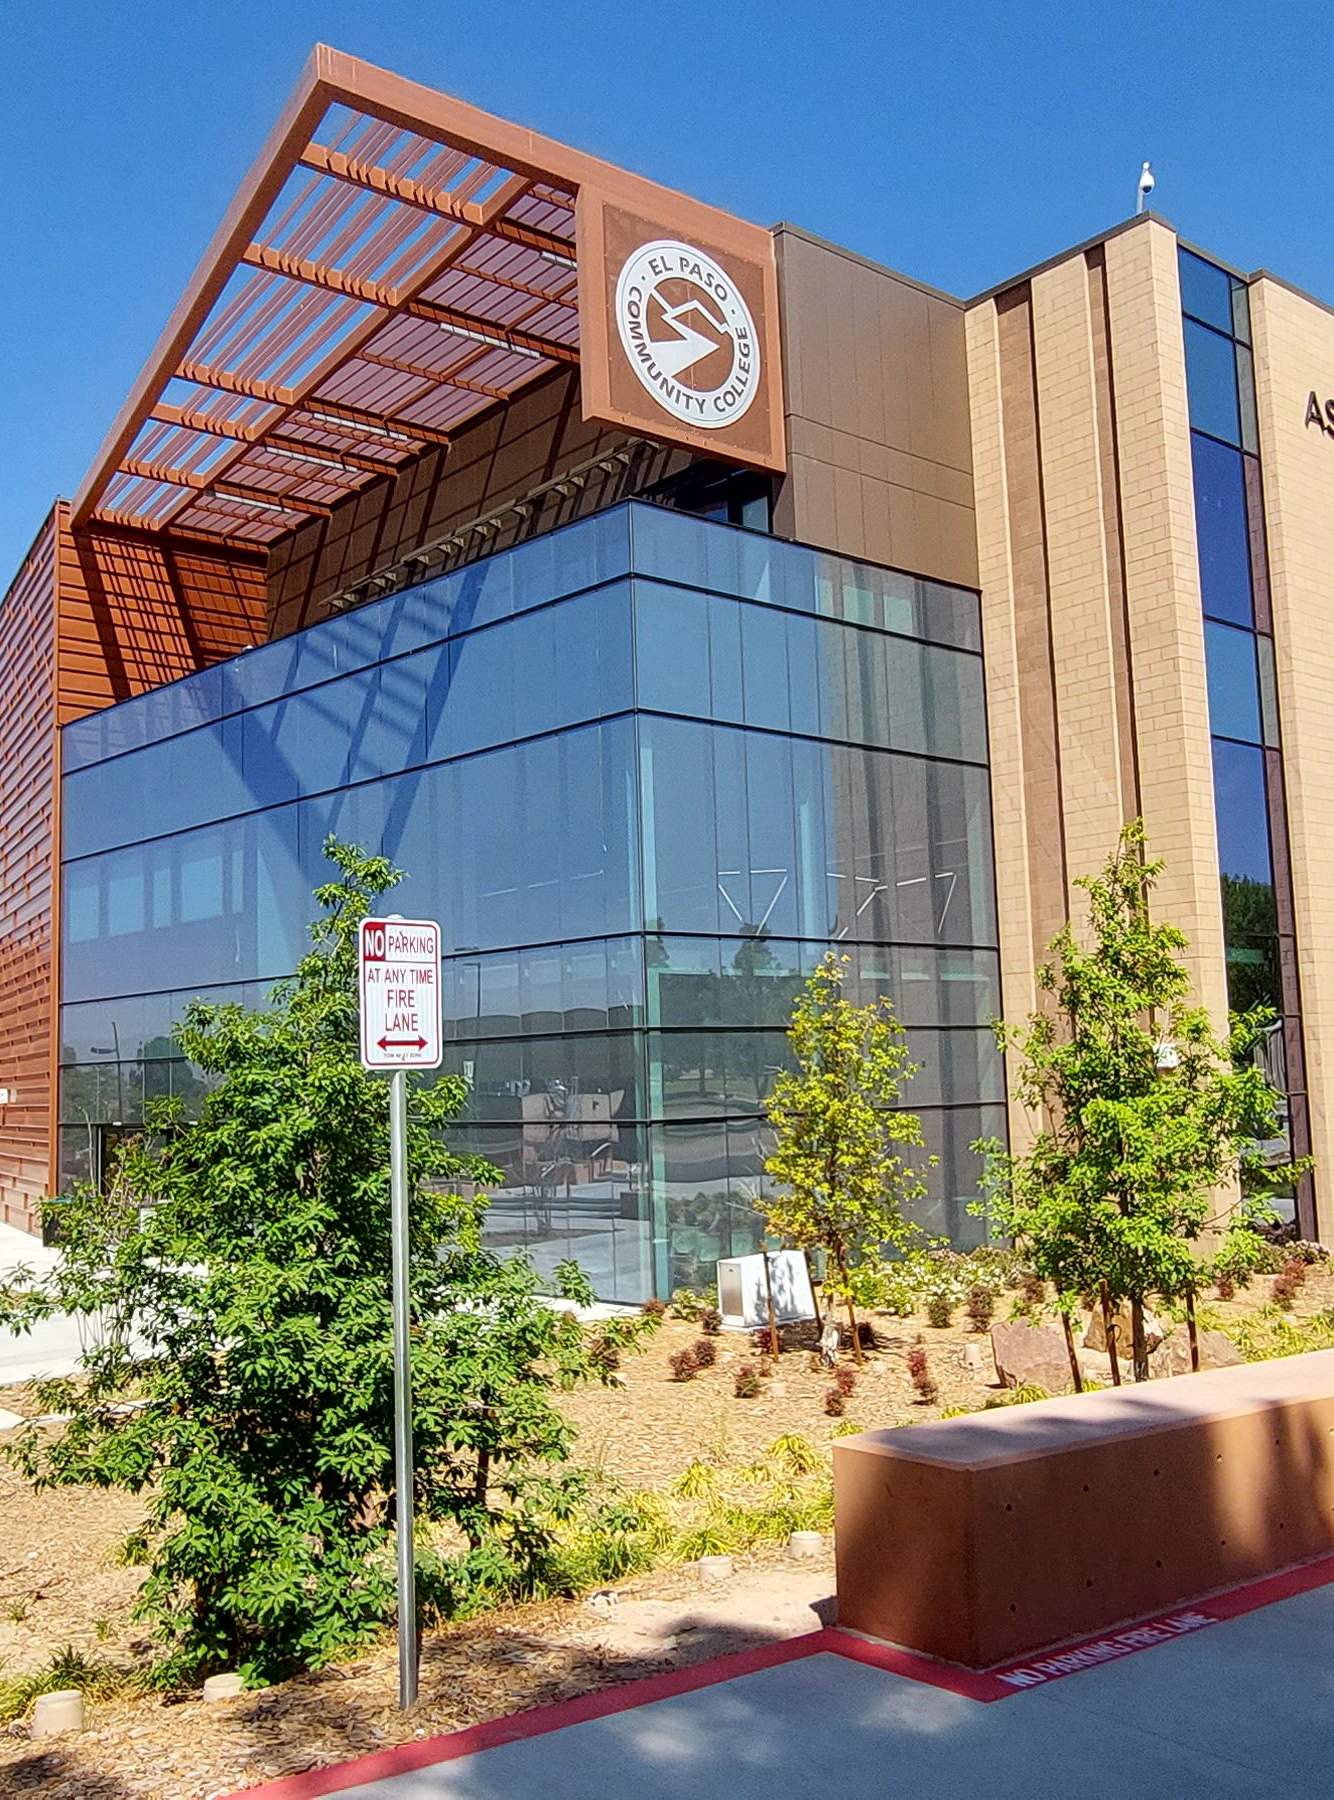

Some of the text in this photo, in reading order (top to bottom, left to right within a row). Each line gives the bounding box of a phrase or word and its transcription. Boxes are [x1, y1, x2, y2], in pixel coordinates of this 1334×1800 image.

[647, 255, 728, 302] EL PASO
[627, 285, 750, 415] COMMUNITY COLLEGE
[365, 929, 434, 957] NO PARKING
[367, 967, 434, 985] AT ANY TIME
[387, 989, 416, 1008] FIRE
[385, 1013, 419, 1032] LANE
[997, 1612, 1218, 1687] NO PARKING FIRE LANE
